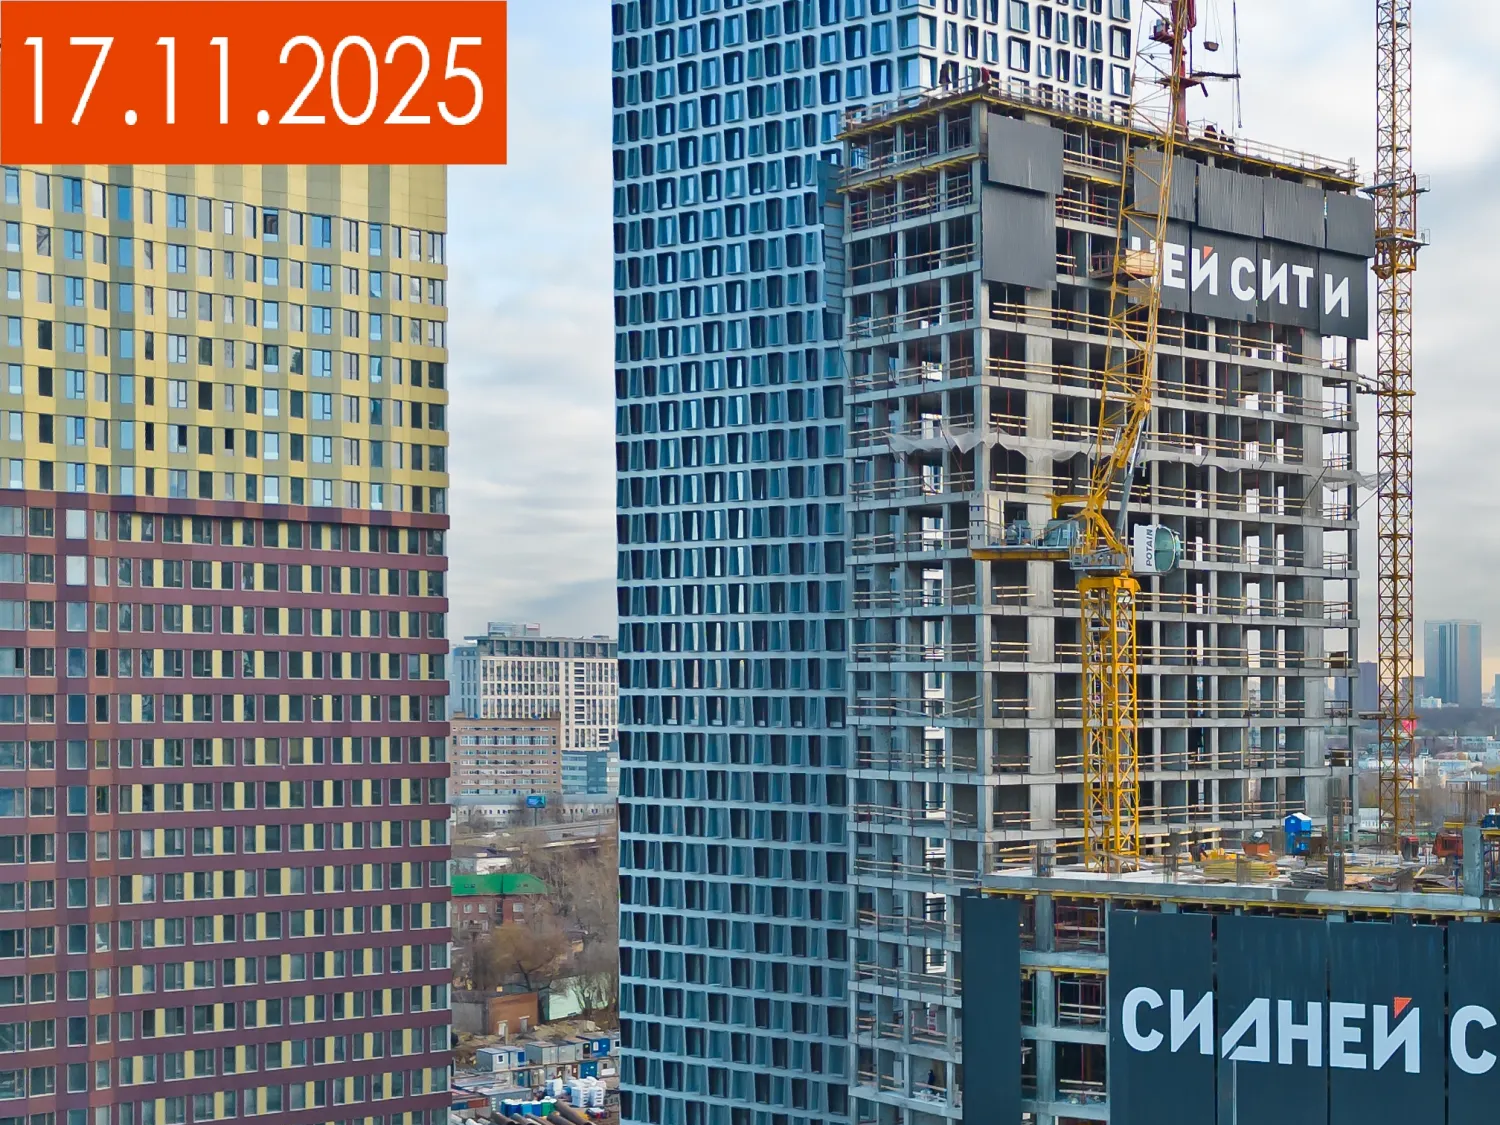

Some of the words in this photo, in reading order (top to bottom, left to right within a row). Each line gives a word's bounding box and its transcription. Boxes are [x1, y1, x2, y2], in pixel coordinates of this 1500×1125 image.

[1231, 256, 1349, 318] СИТИ
[1145, 528, 1153, 567] POTAIN
[1122, 986, 1420, 1074] СИДНЕЙ
